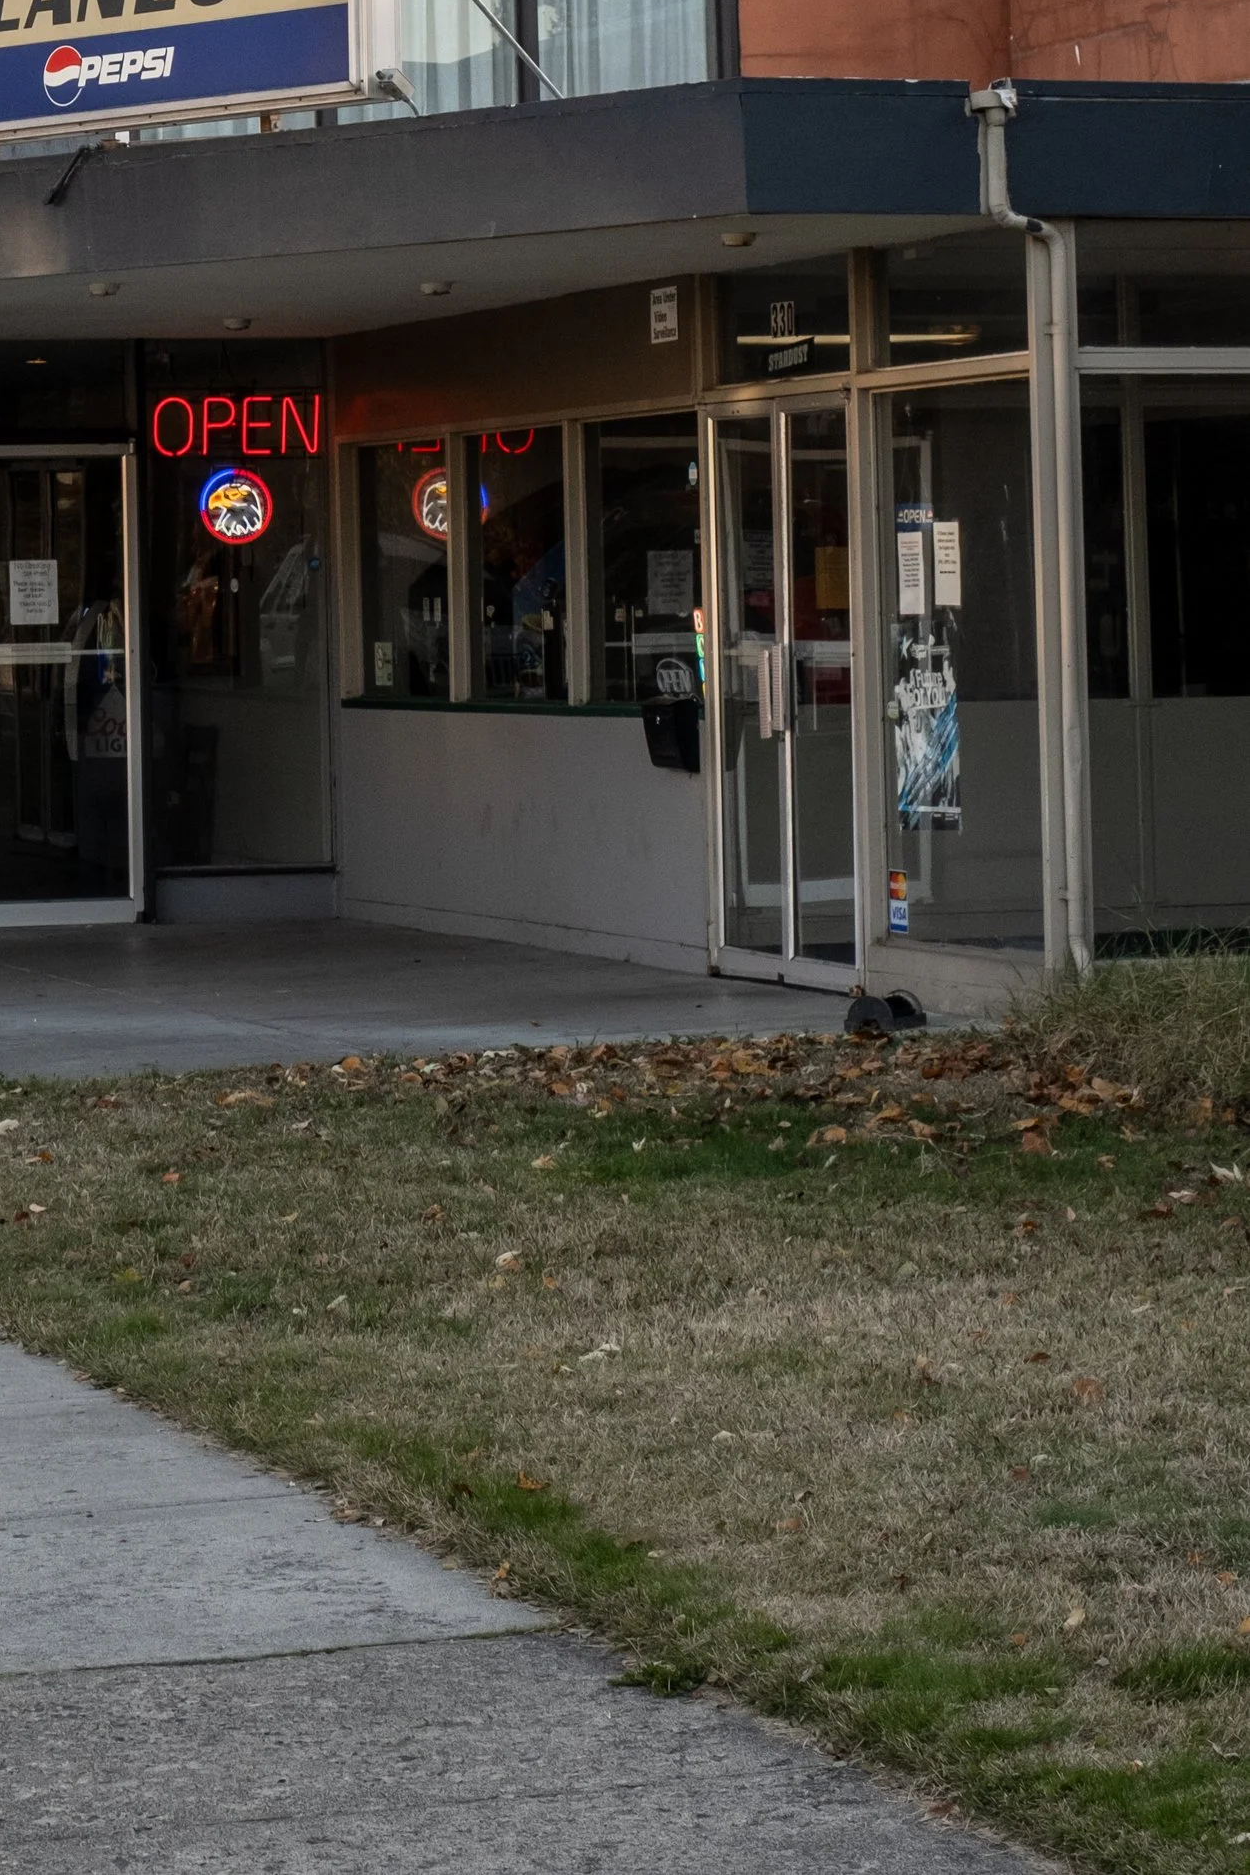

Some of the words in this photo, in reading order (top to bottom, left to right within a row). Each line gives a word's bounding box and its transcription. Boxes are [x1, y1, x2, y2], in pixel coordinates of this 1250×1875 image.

[77, 46, 175, 88] PEPSI
[771, 302, 793, 338] 330
[768, 343, 809, 373] STARDUST
[152, 393, 320, 457] OPEN
[903, 509, 926, 524] OPEN
[657, 669, 692, 693] OPEN
[892, 906, 907, 921] VISA
